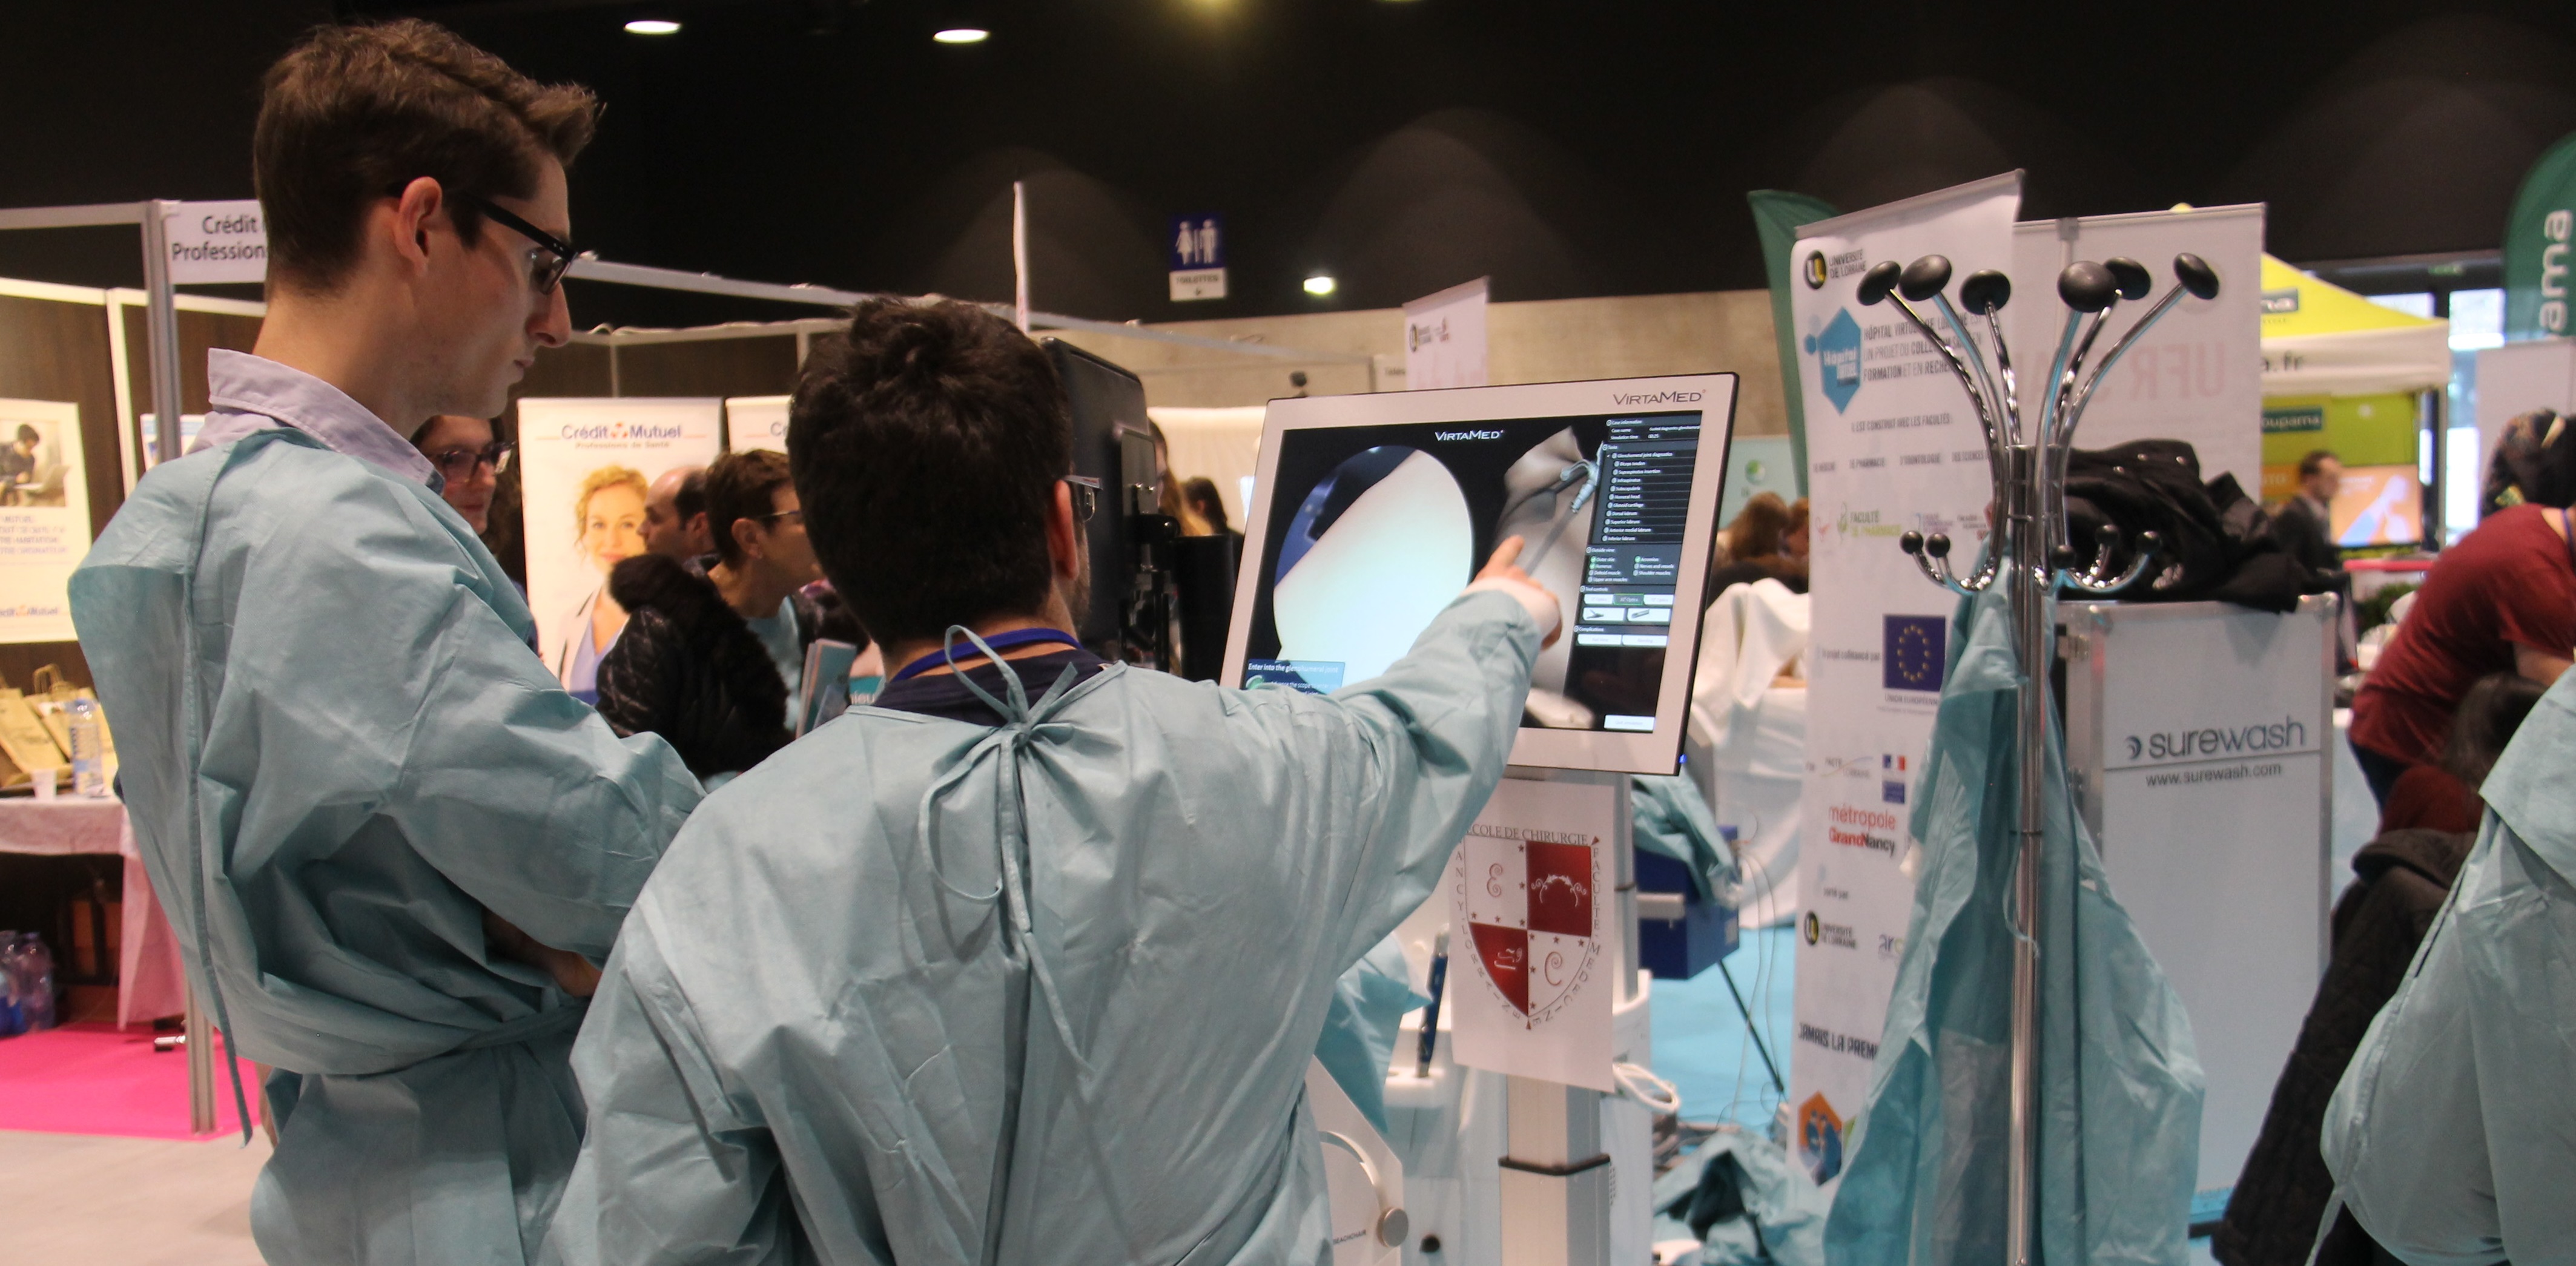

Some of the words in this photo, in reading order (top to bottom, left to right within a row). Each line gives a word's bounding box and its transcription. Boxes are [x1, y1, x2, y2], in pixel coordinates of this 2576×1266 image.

[202, 214, 257, 234] Crédit
[1829, 267, 1839, 279] DE
[1863, 325, 1892, 341] HÔPITAL
[1874, 343, 1900, 359] PROJET
[1900, 345, 1909, 356] DU
[1863, 365, 1902, 381] FORMATION
[1913, 363, 1923, 376] EN
[1911, 415, 1920, 426] LES
[1922, 412, 1951, 426] FACULTÉS
[561, 424, 609, 440] Crédit
[630, 424, 681, 439] Mutuel
[2149, 714, 2304, 758] surewash
[2145, 763, 2281, 786] www.surewash.com
[1829, 804, 1897, 831] métropole
[1504, 827, 1518, 839] DE
[1522, 829, 1588, 846] CHIRURGIE
[1798, 1023, 1829, 1049] JAMAIS
[1832, 1034, 1844, 1052] LA
